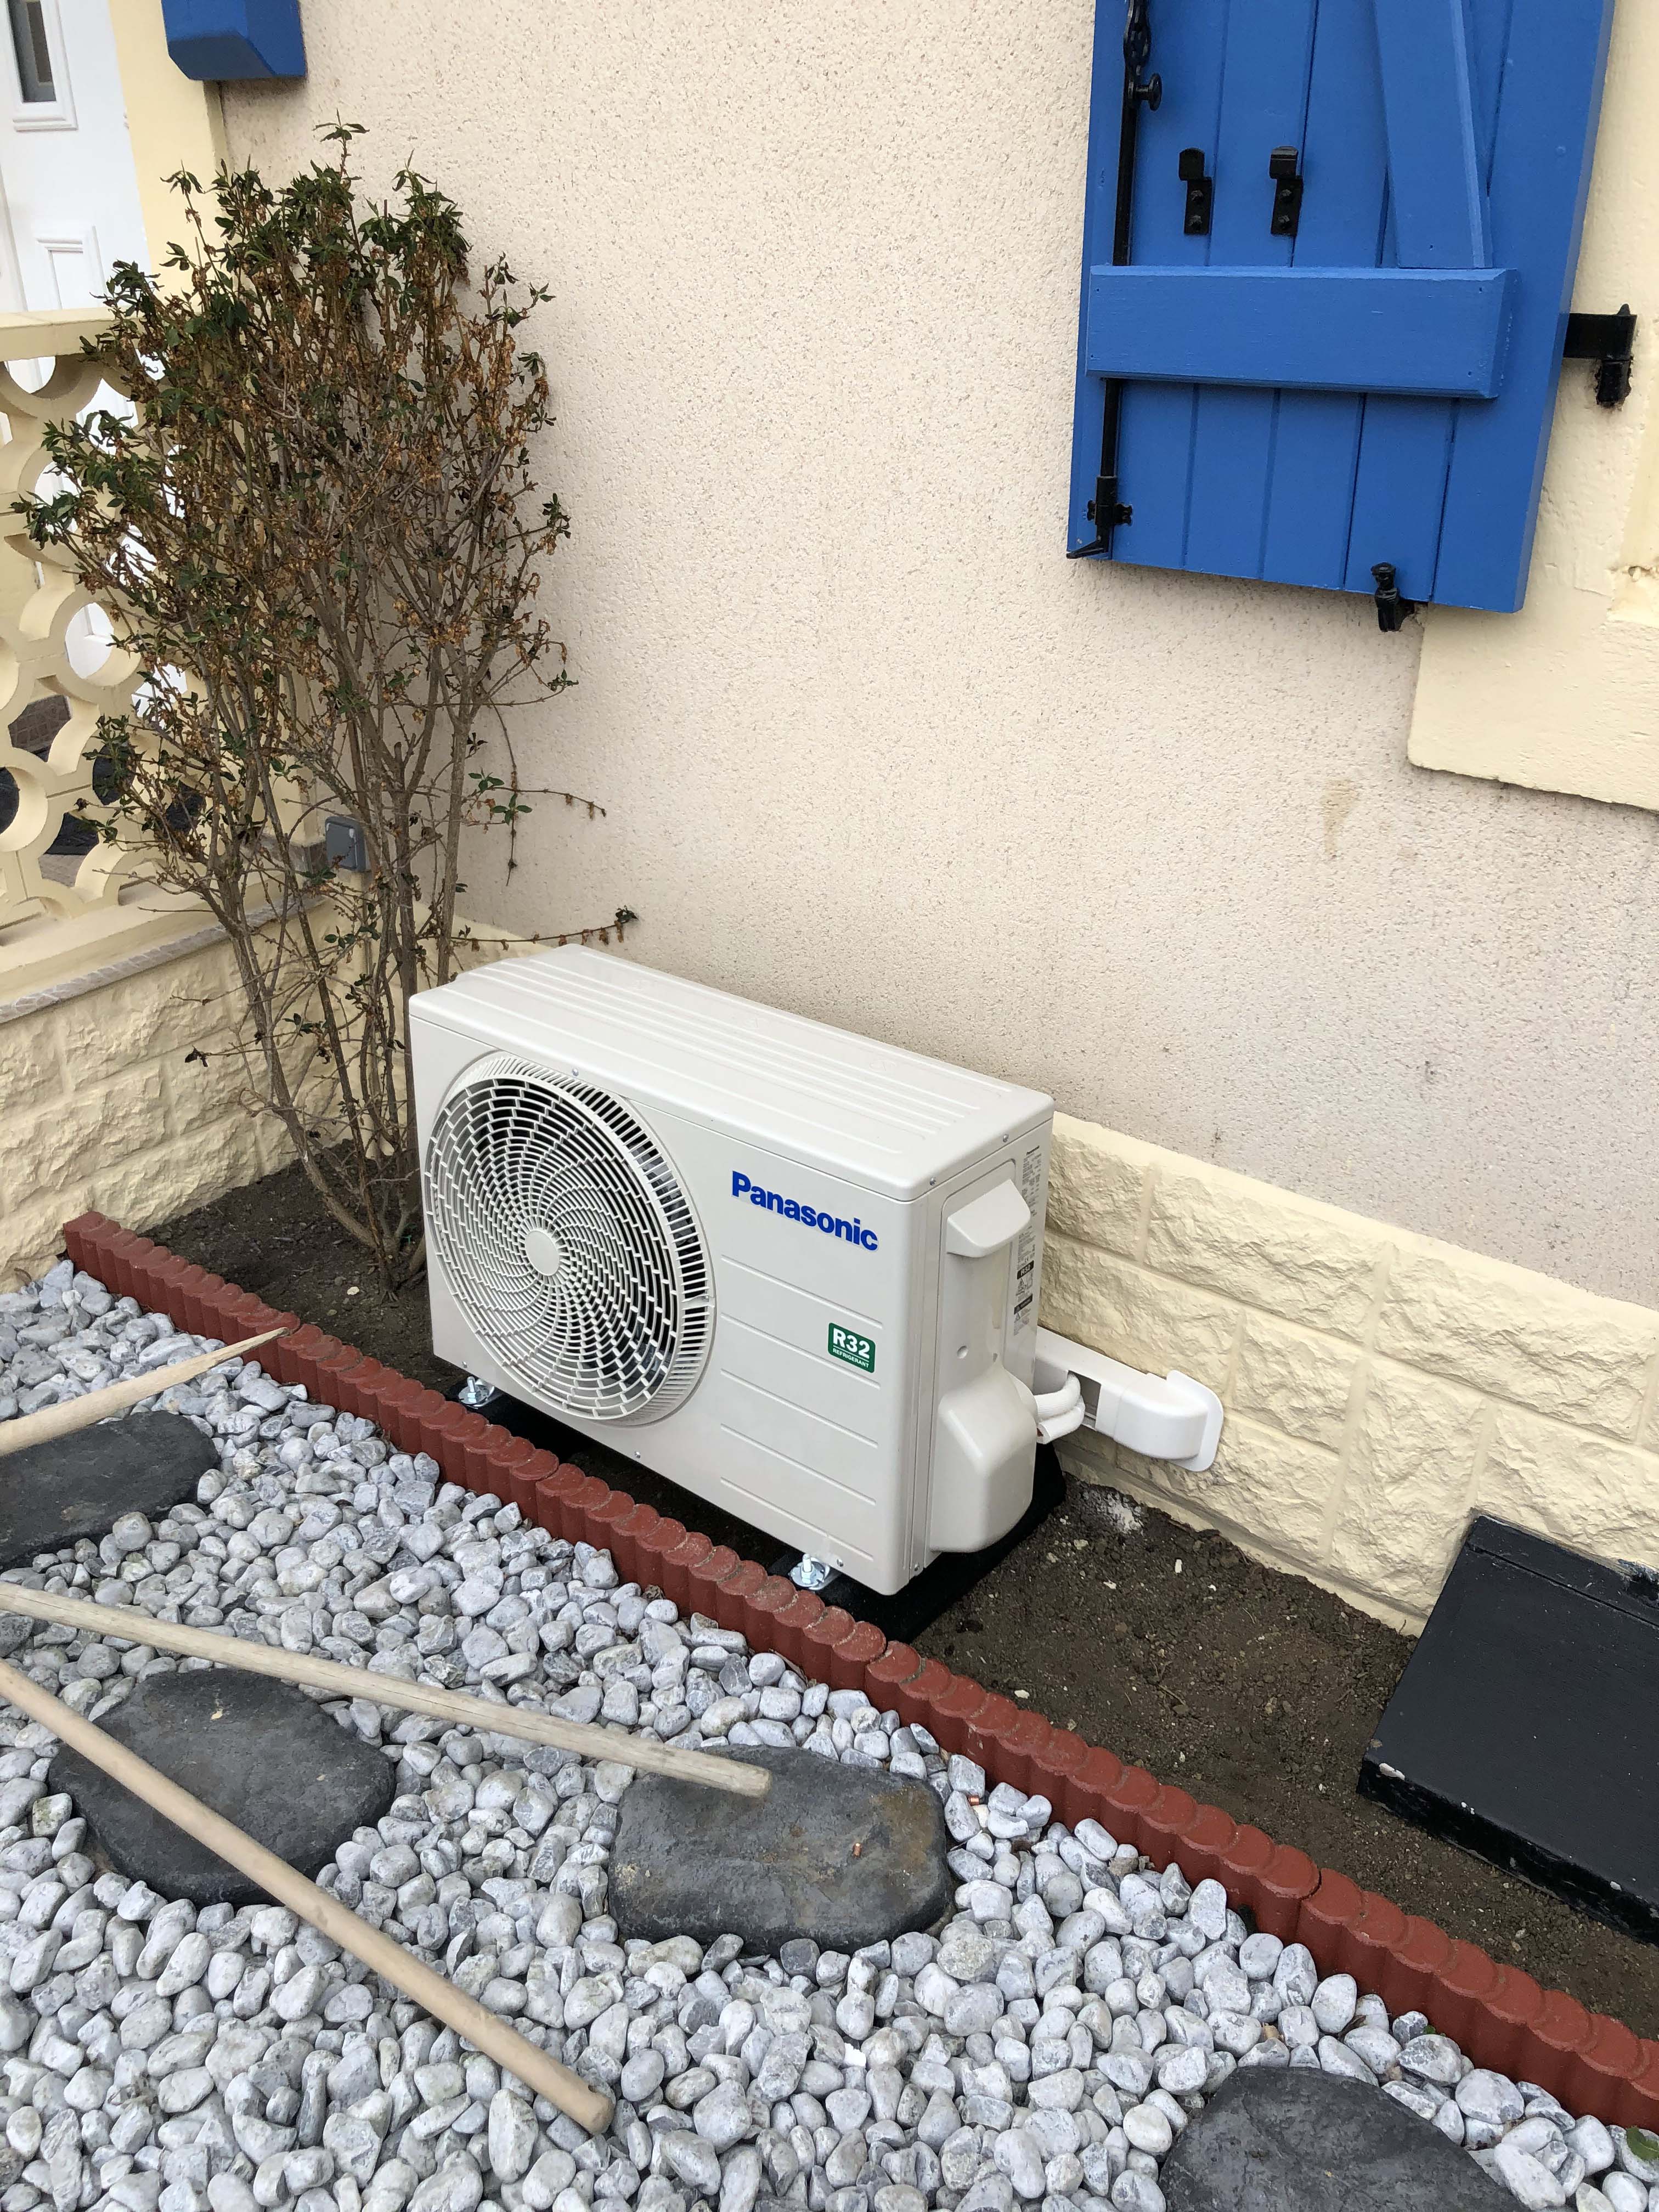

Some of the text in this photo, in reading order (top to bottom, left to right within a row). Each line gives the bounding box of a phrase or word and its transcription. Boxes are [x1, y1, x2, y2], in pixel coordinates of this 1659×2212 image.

[732, 1170, 878, 1251] Panasonic
[833, 1327, 870, 1359] R32
[833, 1347, 869, 1368] REFRIGERANT
